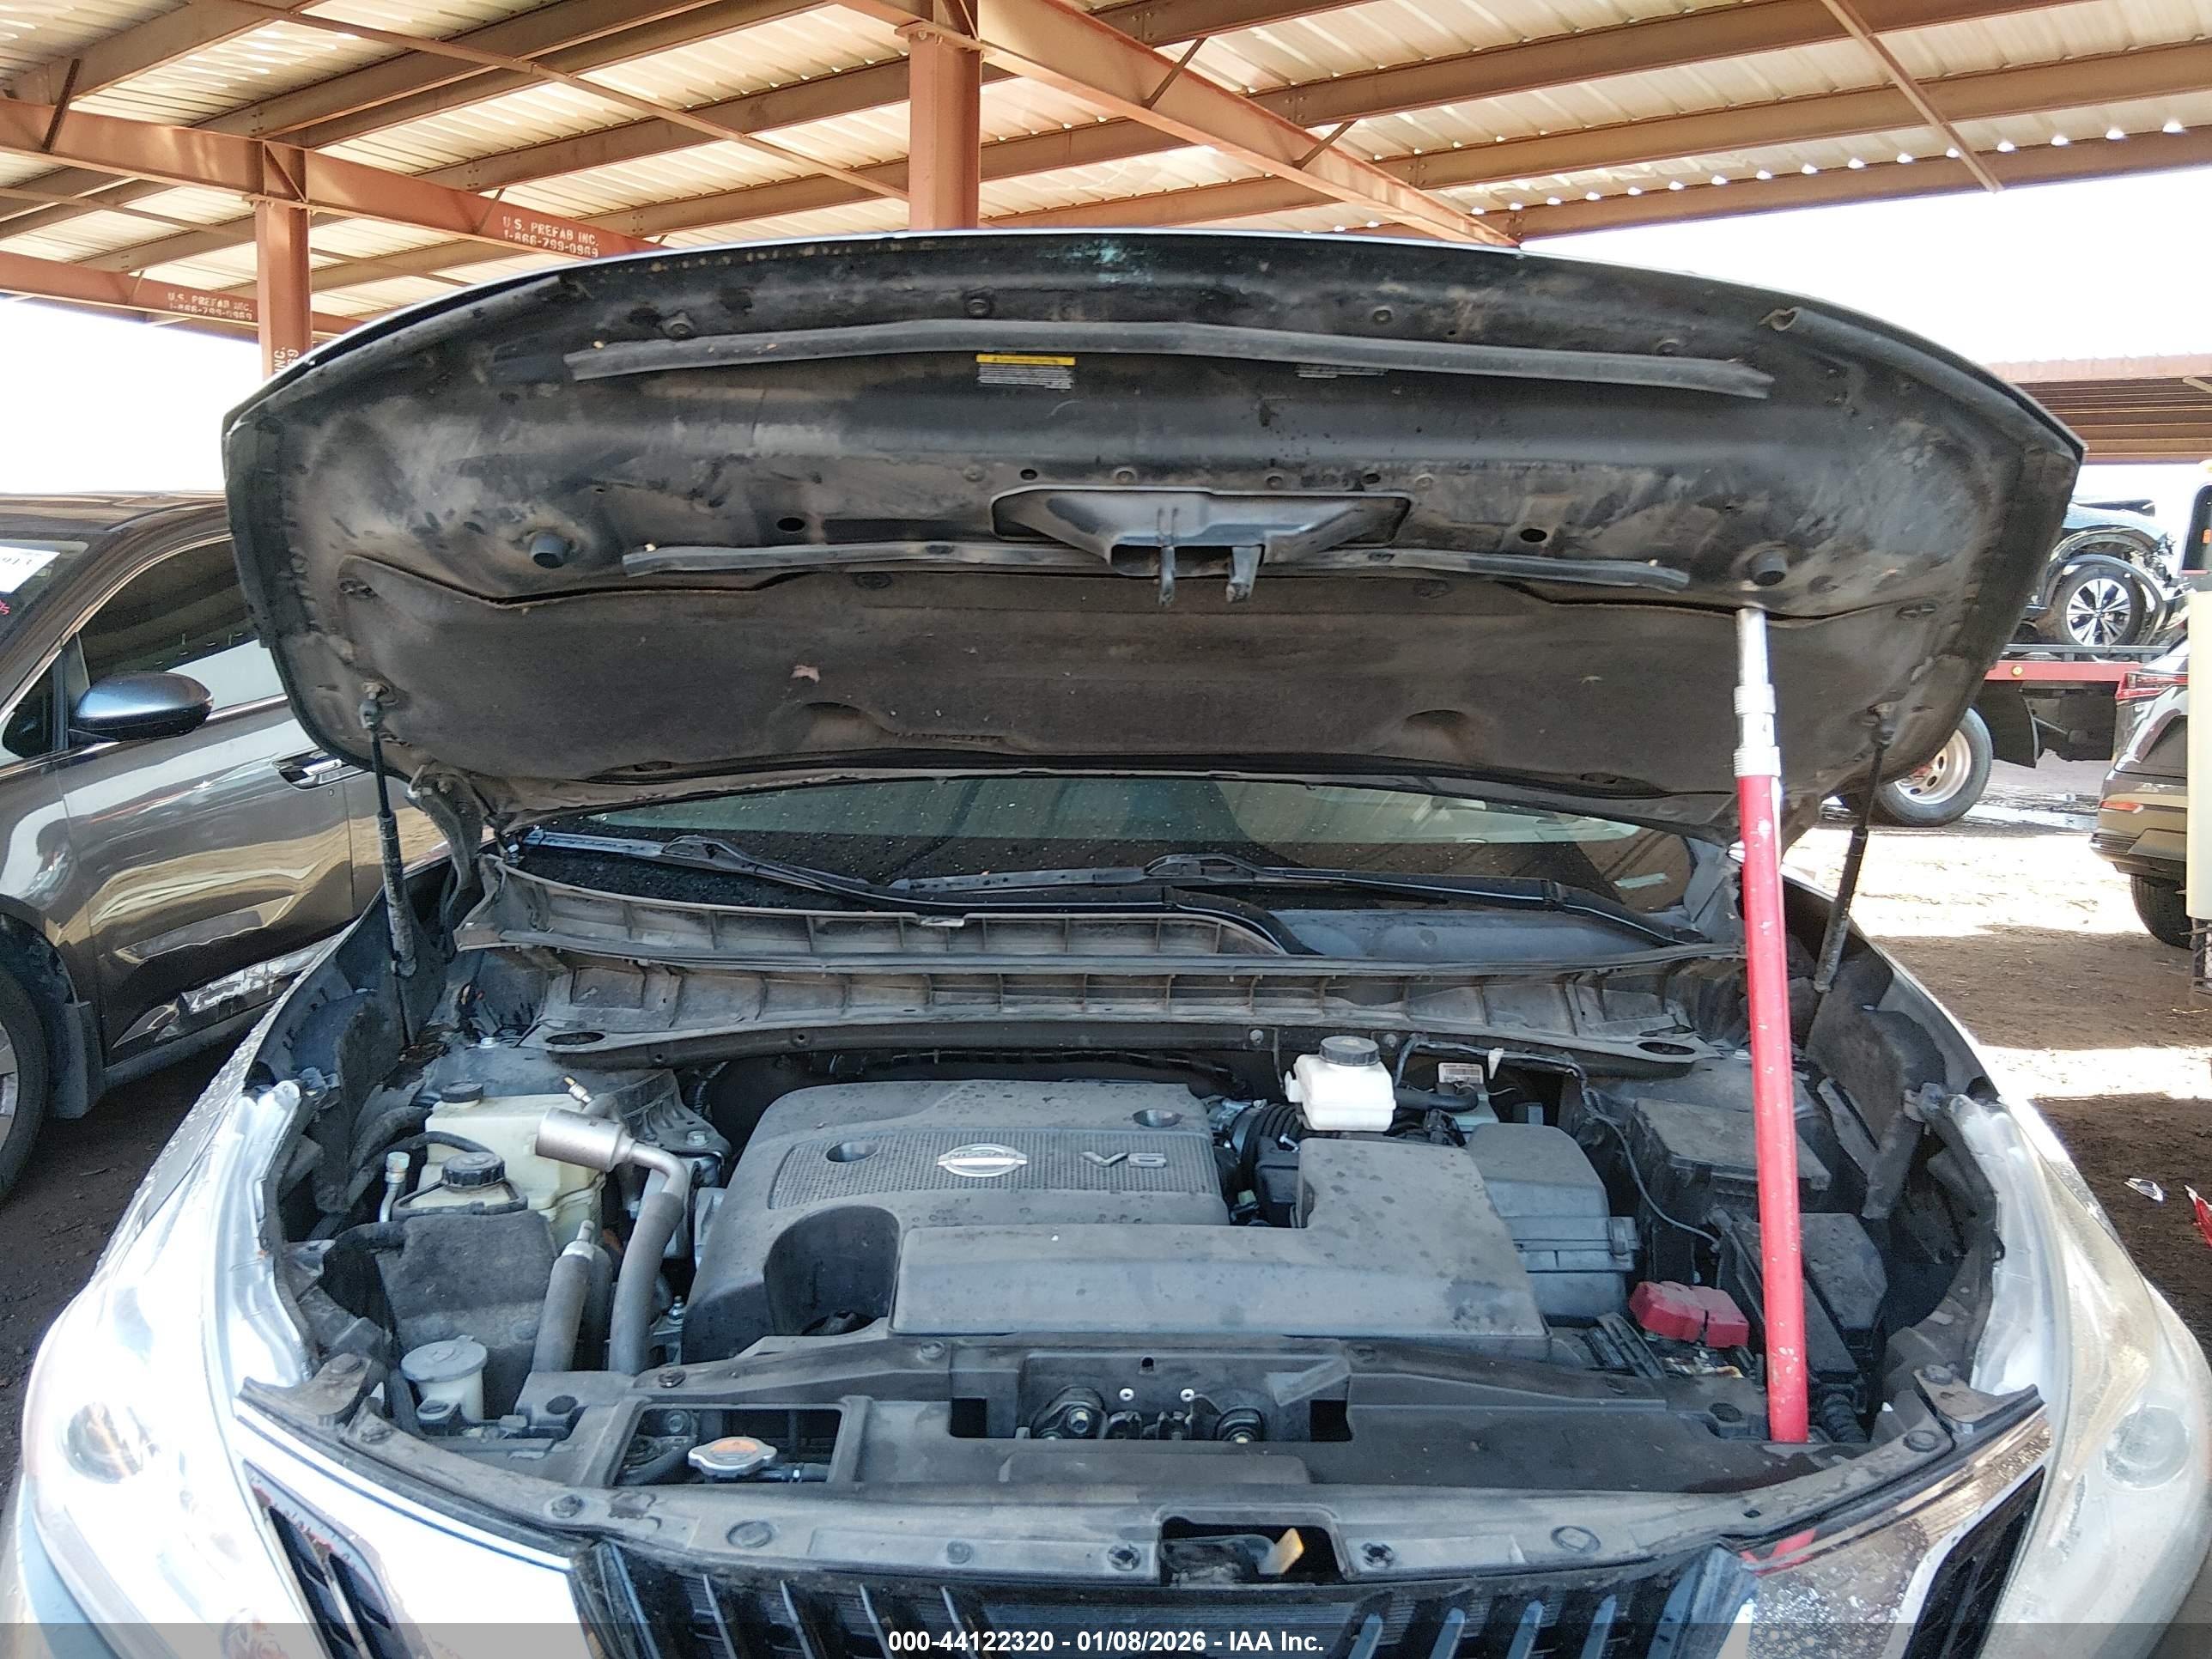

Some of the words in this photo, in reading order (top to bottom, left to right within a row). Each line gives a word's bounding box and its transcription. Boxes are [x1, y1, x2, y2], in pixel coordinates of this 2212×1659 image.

[531, 222, 574, 241] PREFAB
[578, 232, 600, 247] INC.
[1080, 1150, 1168, 1169] V6
